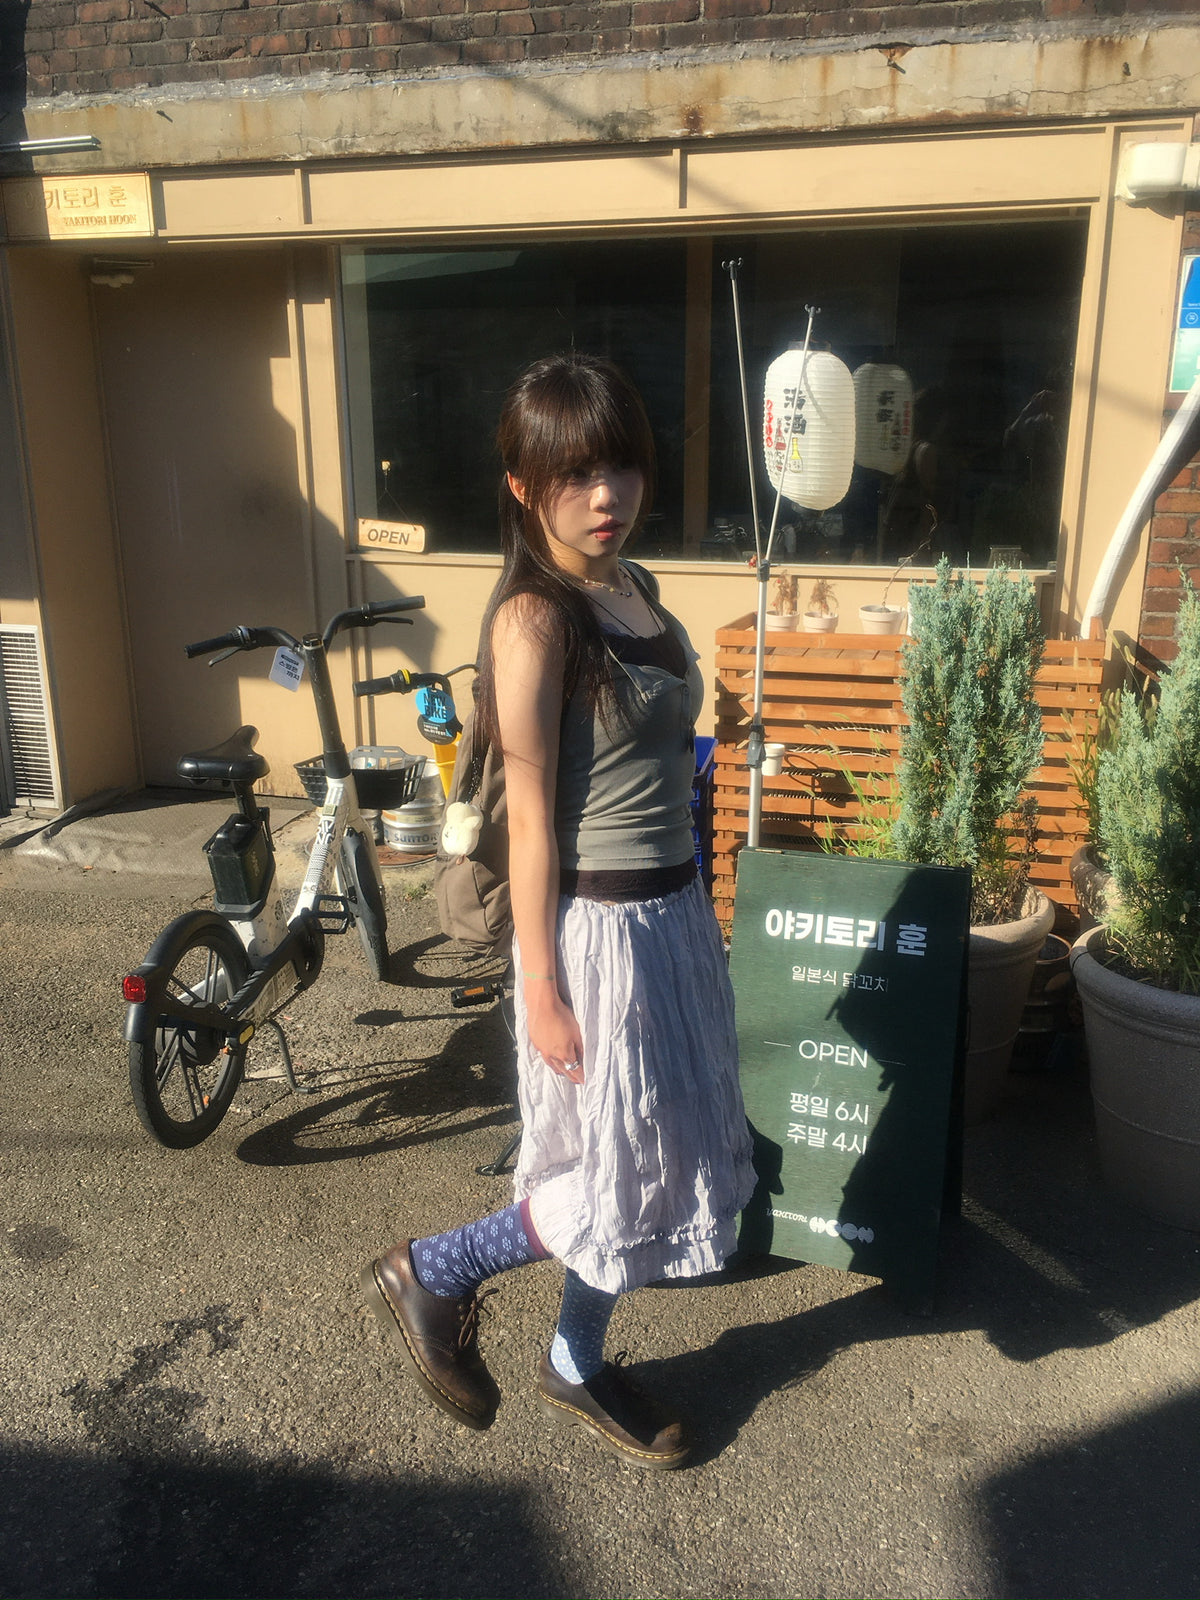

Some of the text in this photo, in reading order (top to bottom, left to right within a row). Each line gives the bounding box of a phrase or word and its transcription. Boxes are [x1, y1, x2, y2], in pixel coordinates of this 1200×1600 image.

[109, 185, 127, 208] 훈
[367, 528, 410, 546] OPEN
[423, 693, 446, 707] NEW
[424, 705, 447, 720] BIKE
[765, 908, 928, 957] 야키토리 훈
[791, 965, 889, 993] 일본식 닭꼬치
[798, 1039, 868, 1069] OPEN
[790, 1092, 869, 1126] 평일 6시
[786, 1122, 868, 1156] 주말 4시
[808, 1214, 875, 1244] HOON
